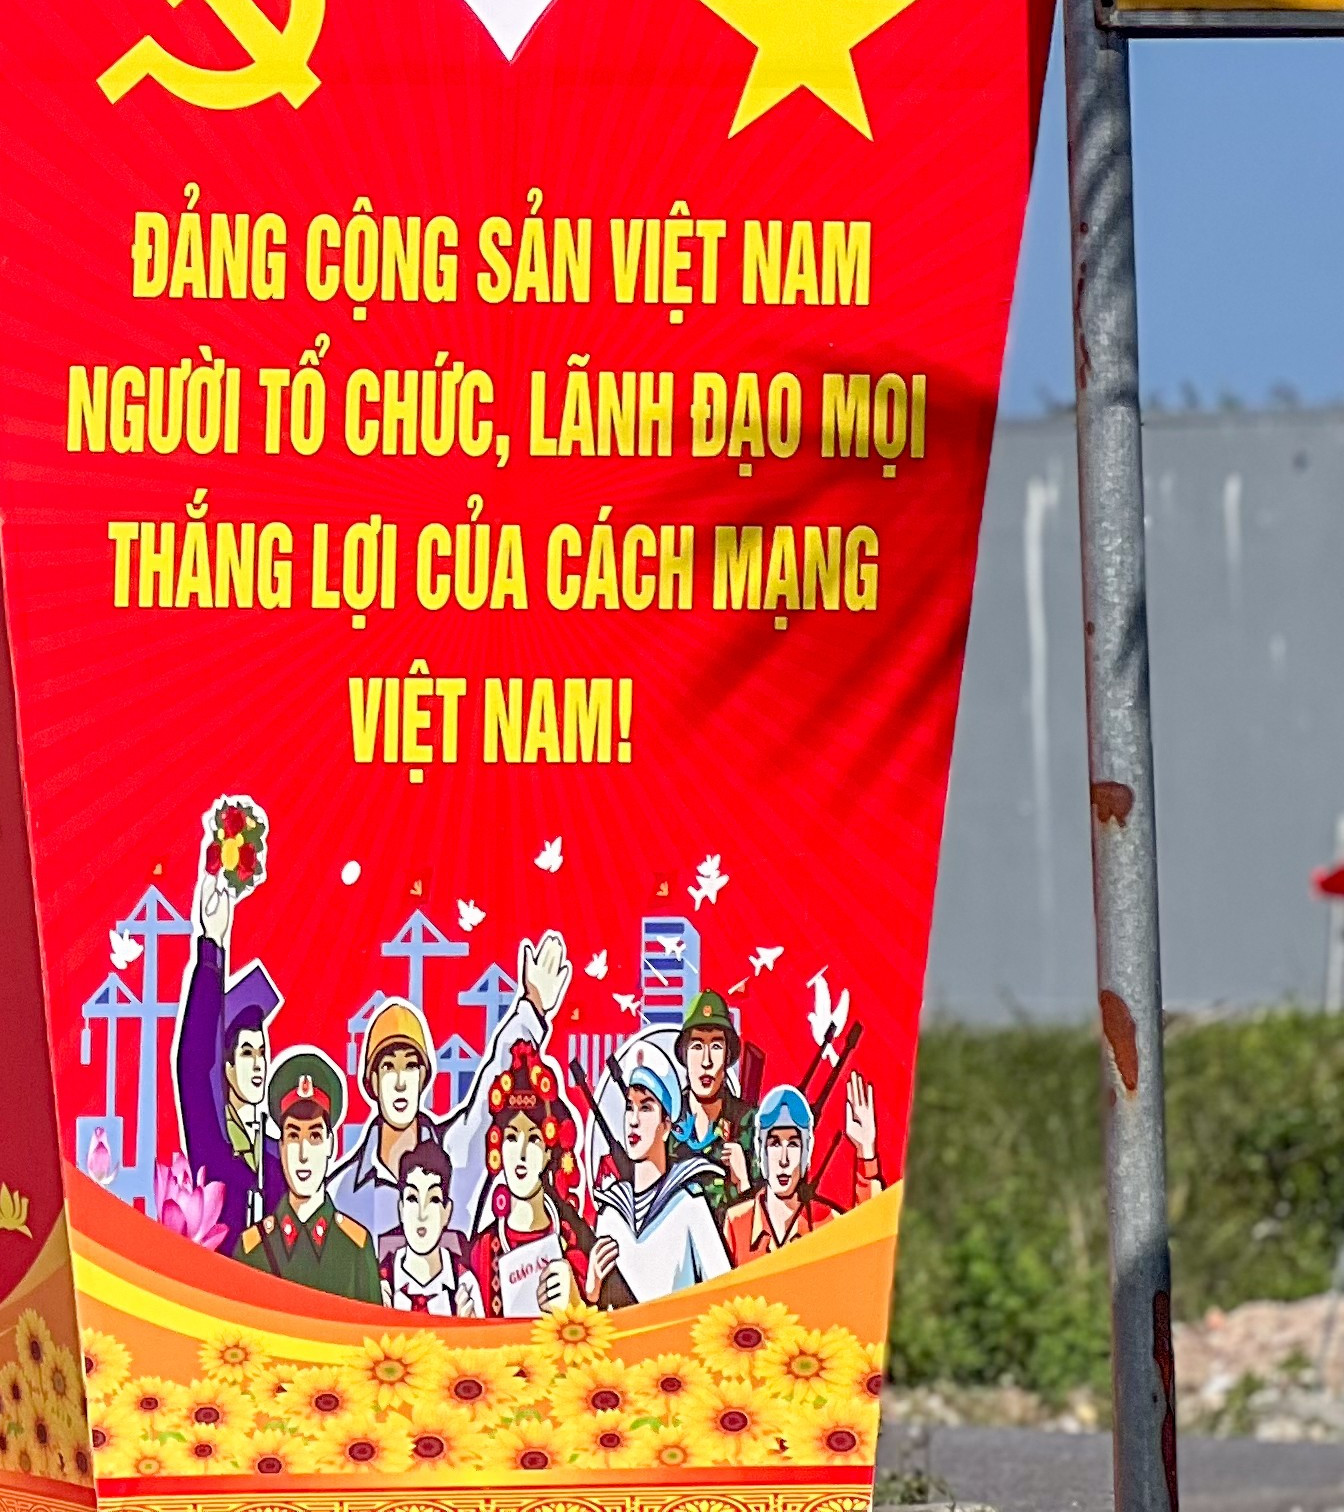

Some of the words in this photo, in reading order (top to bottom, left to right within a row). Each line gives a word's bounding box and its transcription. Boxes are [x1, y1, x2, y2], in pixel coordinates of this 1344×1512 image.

[130, 181, 288, 302] ĐẢNG
[306, 197, 459, 322] CỘNG
[476, 187, 593, 304] SẢN
[610, 200, 727, 325] VIỆT
[742, 219, 872, 306] NAM
[66, 345, 241, 455] NGƯỜI
[259, 332, 331, 455] TỔ
[344, 350, 511, 468] CHỨC,
[529, 354, 675, 458] LÃNH
[689, 372, 803, 478] ĐẠO
[821, 374, 927, 479] MỌI
[107, 488, 294, 610] THẮNG
[311, 514, 398, 630] LỢI
[416, 494, 529, 611] CỦA
[546, 505, 695, 612] CÁCH
[712, 525, 879, 631] MẠNG
[349, 658, 468, 784] VIỆT
[483, 677, 634, 764] NAM!
